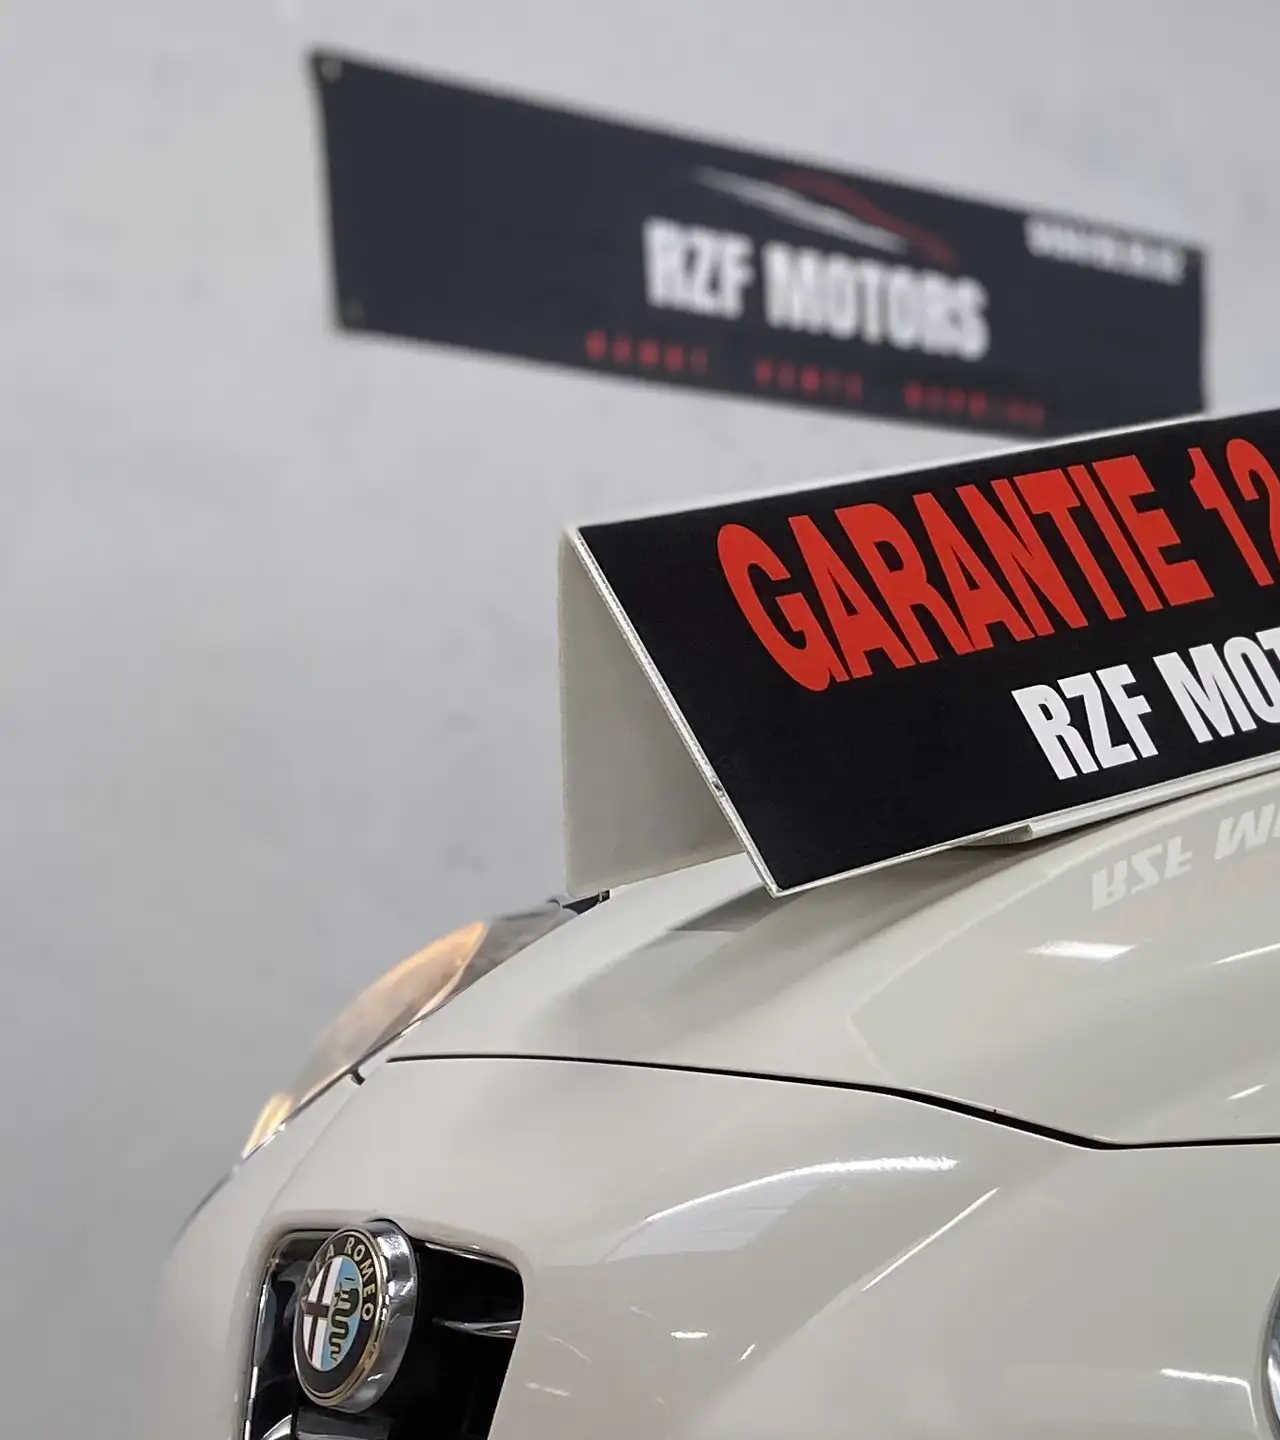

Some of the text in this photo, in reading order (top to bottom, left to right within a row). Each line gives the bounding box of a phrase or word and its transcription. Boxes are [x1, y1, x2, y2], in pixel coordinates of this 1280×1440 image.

[644, 218, 753, 318] RZF
[763, 243, 988, 360] MOTORS
[716, 455, 1215, 692] GARANTIE
[1010, 663, 1159, 781] RZF
[343, 1236, 376, 1321] ROMEO
